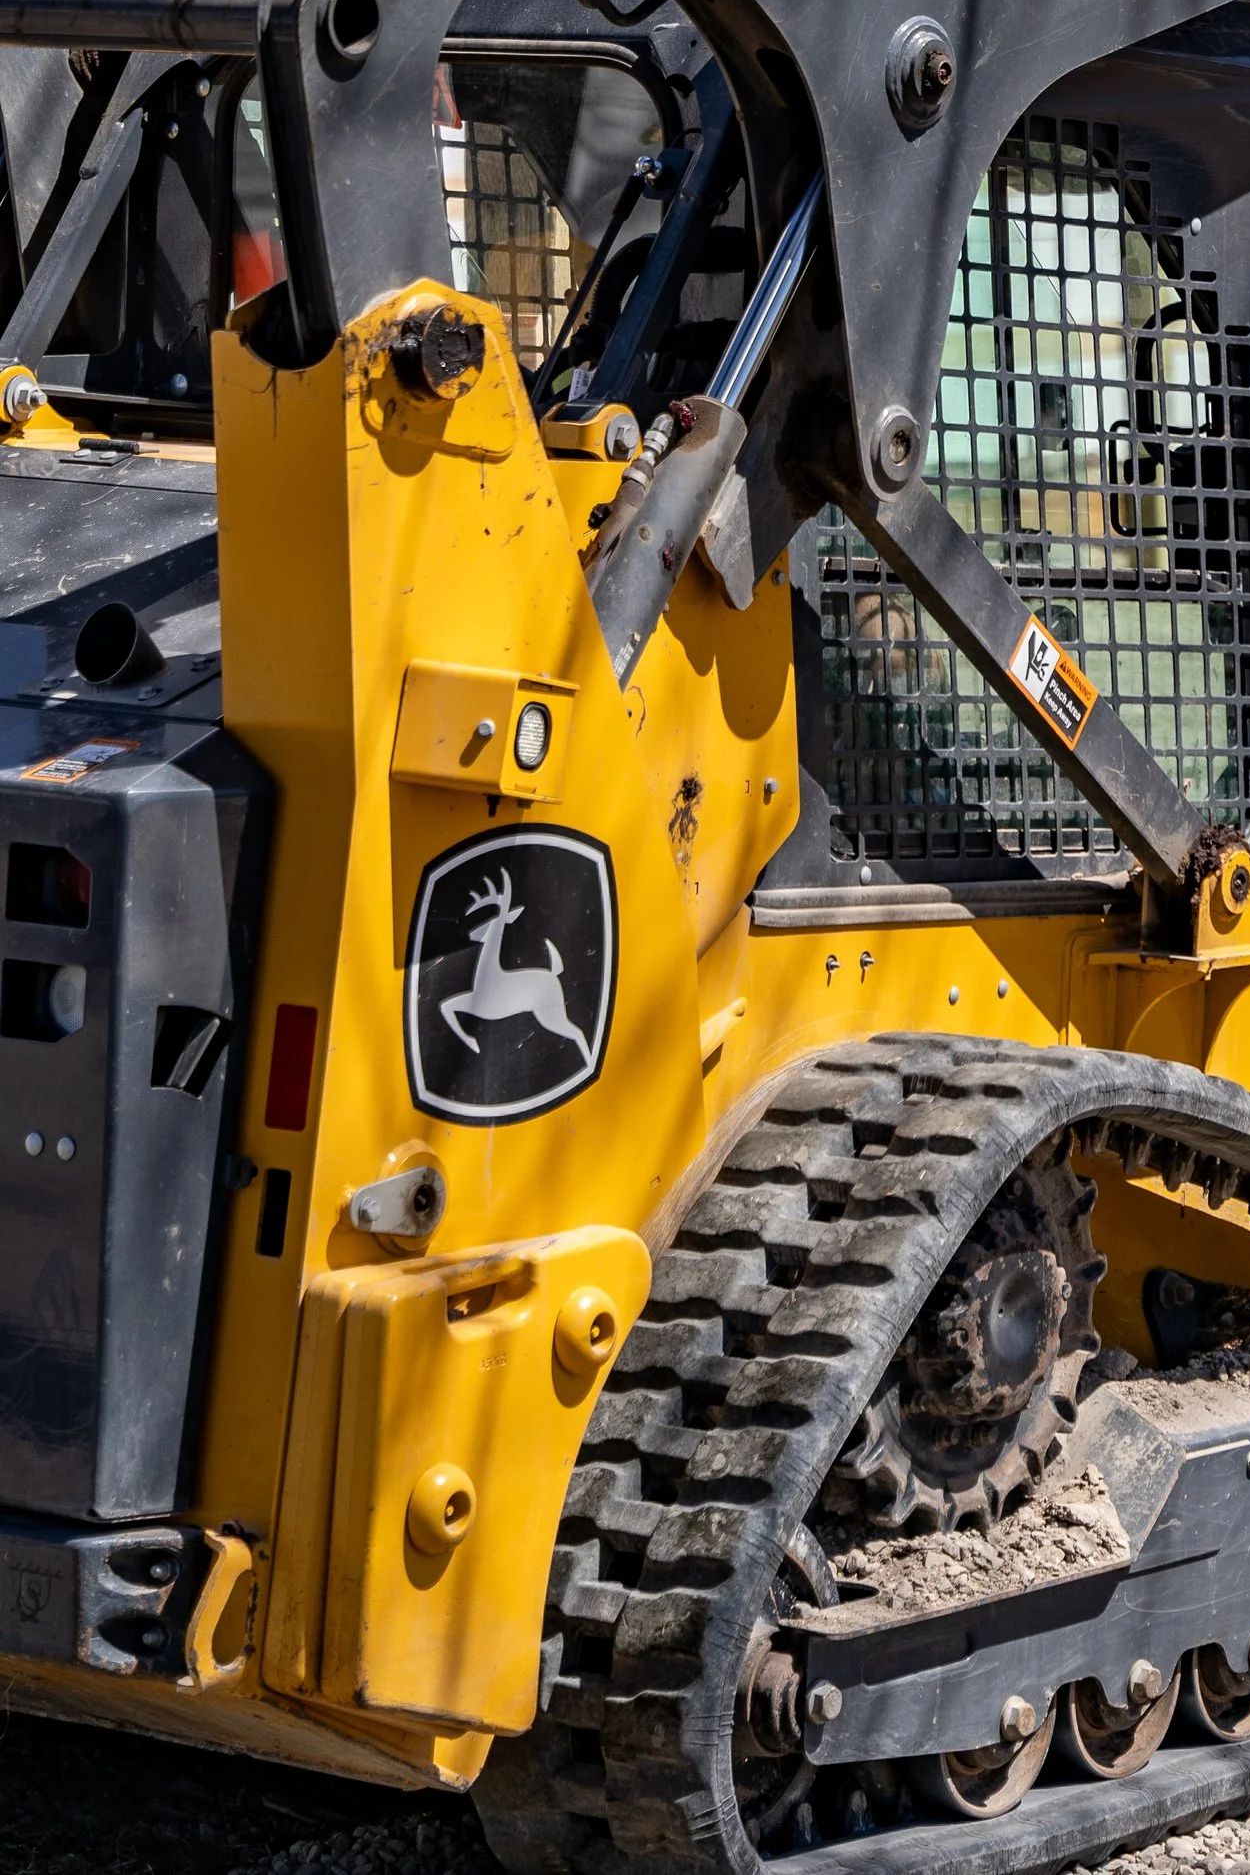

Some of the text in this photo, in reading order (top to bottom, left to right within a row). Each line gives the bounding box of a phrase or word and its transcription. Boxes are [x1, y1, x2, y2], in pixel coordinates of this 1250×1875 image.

[1049, 679, 1082, 722] Pinch Area
[1066, 668, 1092, 702] WARNING
[1044, 691, 1072, 729] Keep Away
